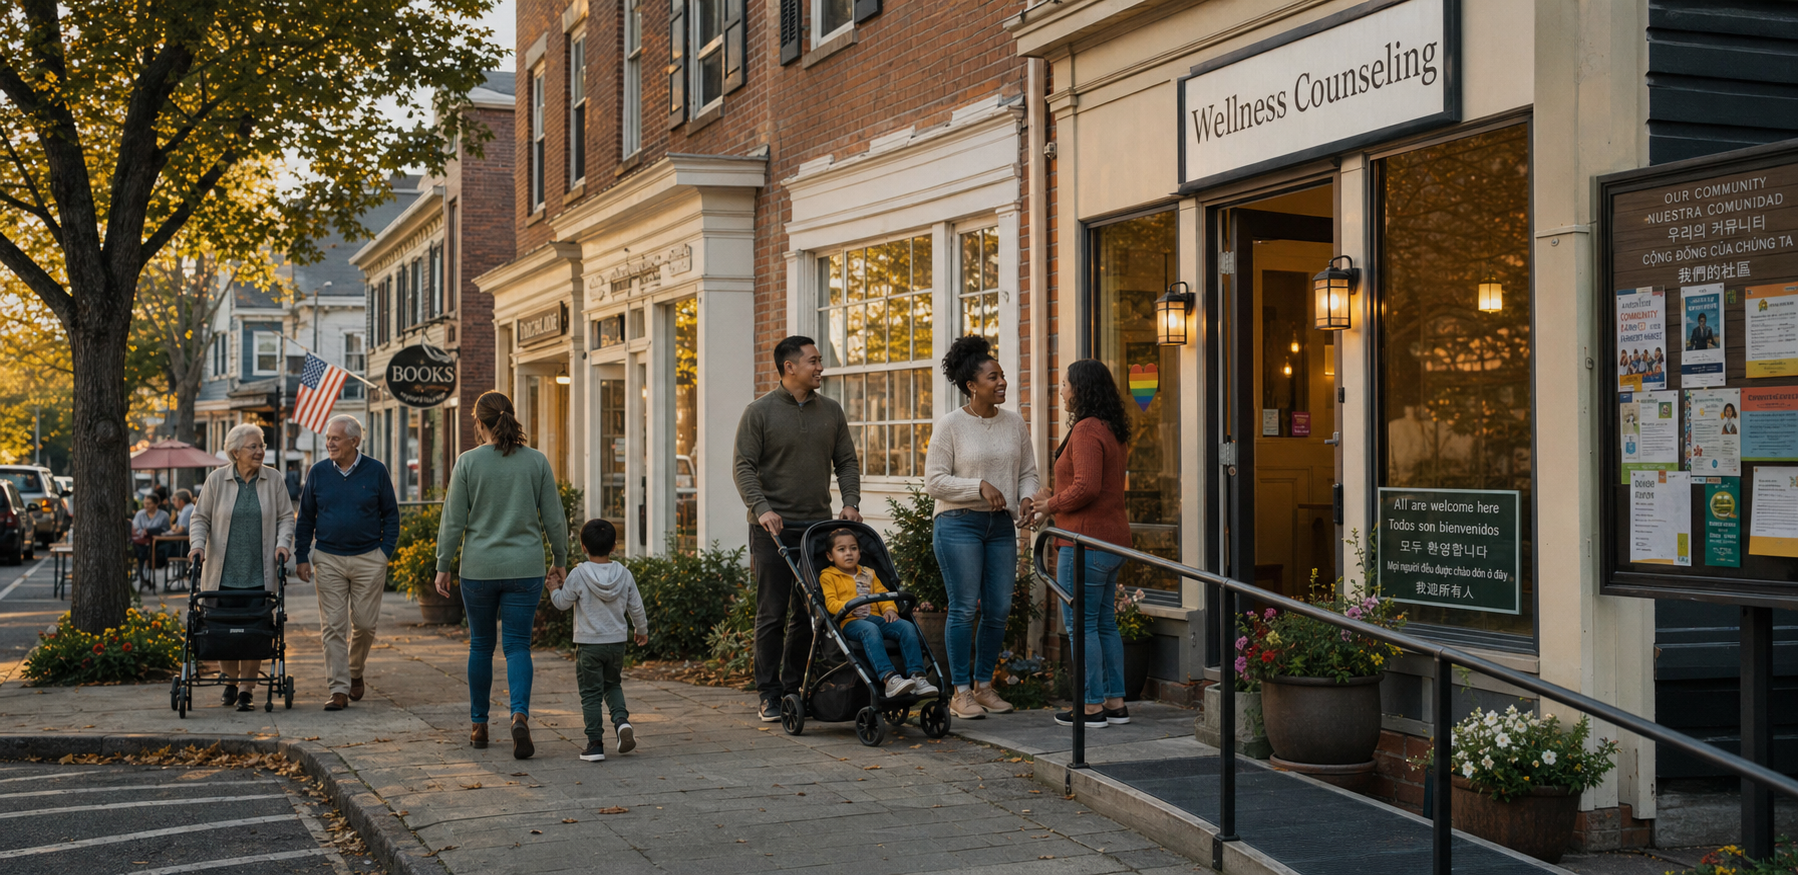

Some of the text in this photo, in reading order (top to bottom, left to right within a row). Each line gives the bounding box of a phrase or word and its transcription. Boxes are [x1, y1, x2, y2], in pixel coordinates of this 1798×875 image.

[1191, 41, 1438, 144] Wellness Counseling
[1664, 177, 1767, 205] OUR COMMUNITY
[1648, 193, 1783, 224] NUESTRA COMUNIDAD
[1668, 214, 1765, 243] 우리의 커뮤니티
[1778, 235, 1793, 248] TA
[1677, 260, 1751, 283] 我們的社區
[391, 365, 454, 383] BOOKS
[1394, 498, 1499, 514] All are welcome here
[1388, 518, 1499, 536] Todos son bienvenidos
[1400, 540, 1422, 554] 모두
[1387, 560, 1400, 573] Mọi
